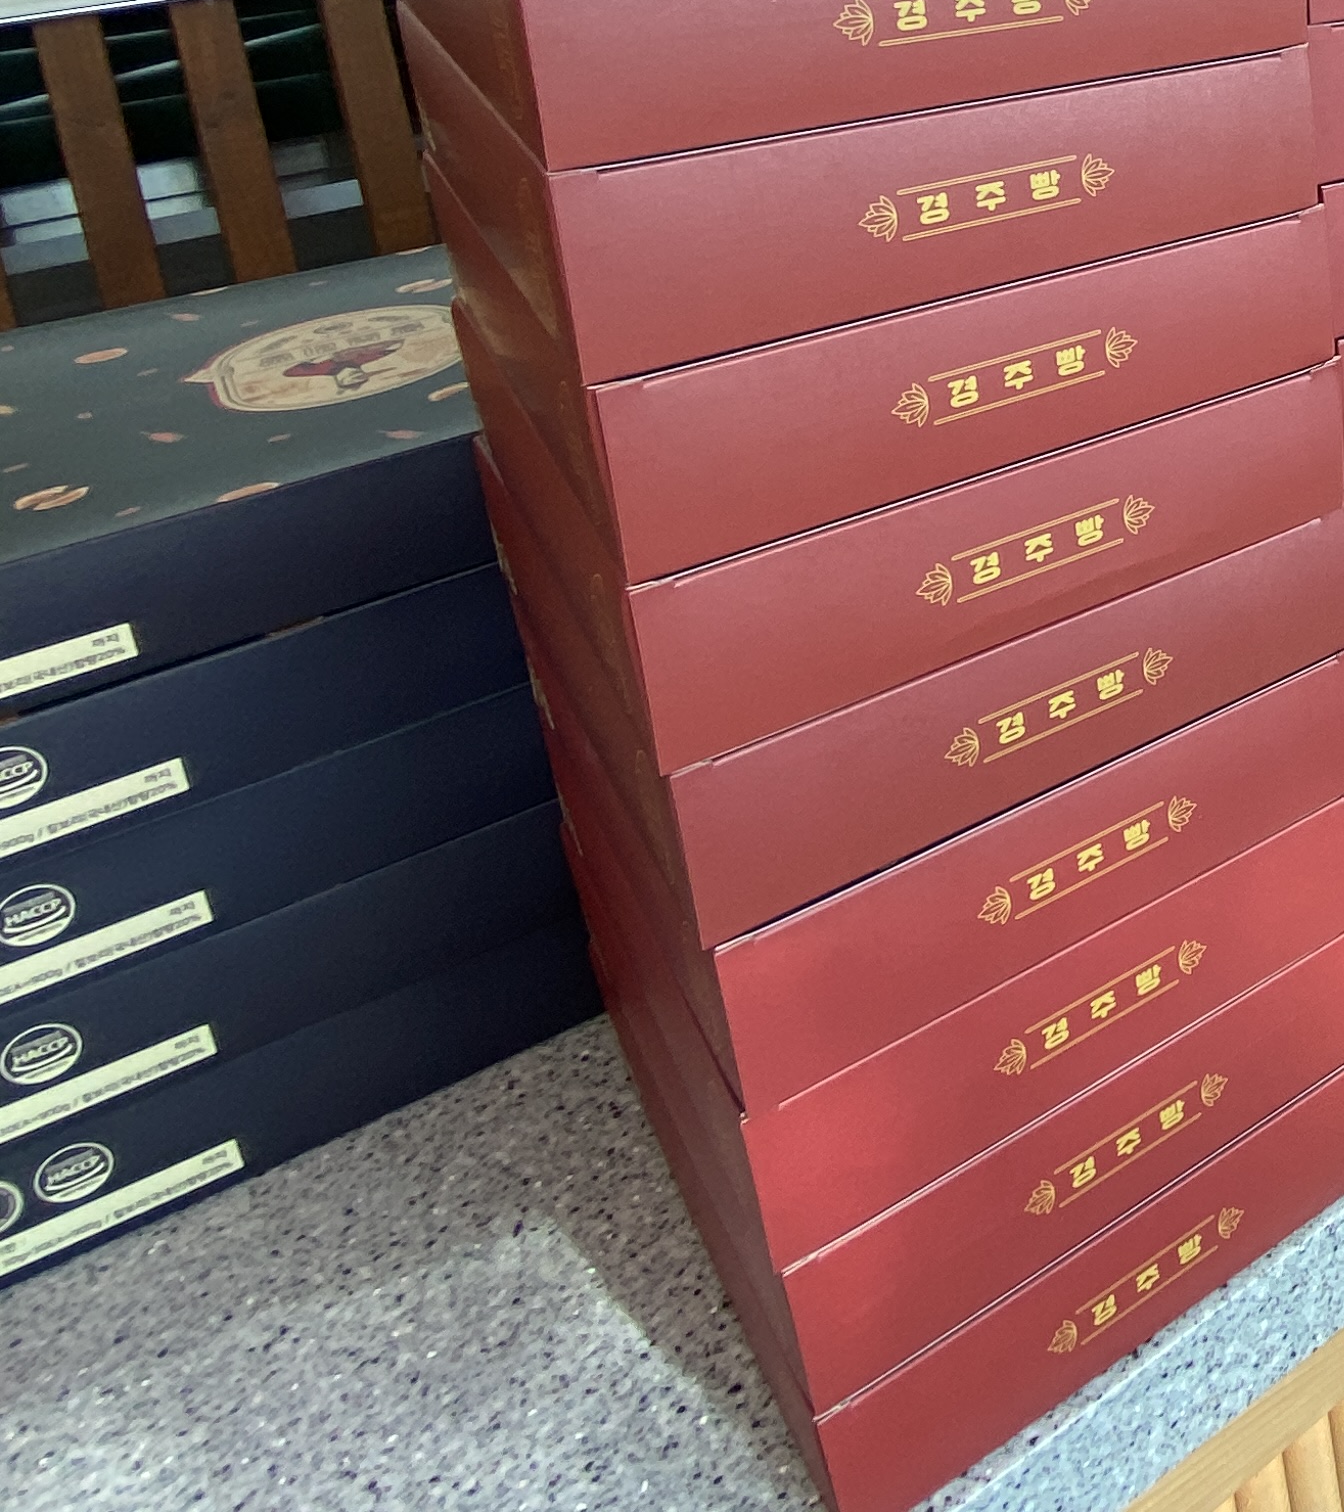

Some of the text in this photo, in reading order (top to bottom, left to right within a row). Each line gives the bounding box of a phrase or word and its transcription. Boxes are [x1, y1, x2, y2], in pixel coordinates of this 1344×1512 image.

[917, 163, 1060, 233] 경주빵
[948, 344, 1090, 412] 경주빵
[971, 515, 1103, 584] 경주빵
[997, 670, 1124, 743] 경주빵
[1028, 820, 1150, 899] 경주빵
[5, 898, 62, 929] HACCP
[1042, 965, 1160, 1049] 경주빵
[13, 1038, 69, 1069] HACCP
[47, 1155, 102, 1187] HACCP
[1071, 1100, 1184, 1187] 경주빵
[1092, 1235, 1205, 1328] 경주빵
